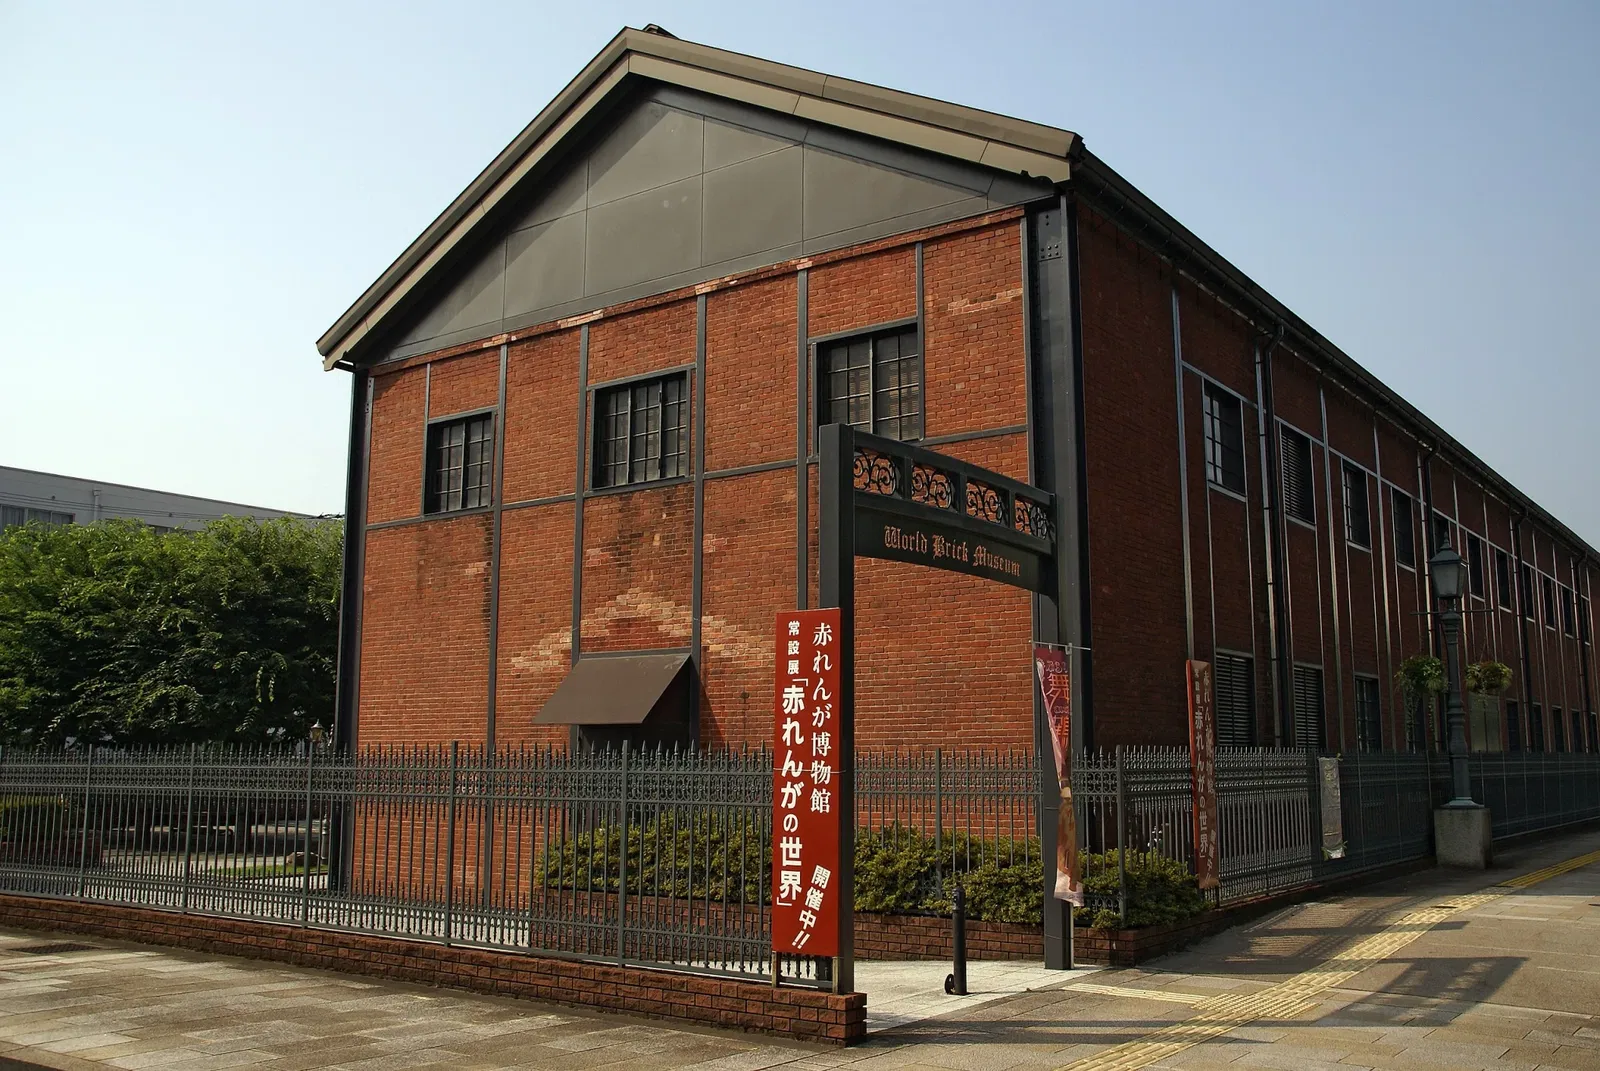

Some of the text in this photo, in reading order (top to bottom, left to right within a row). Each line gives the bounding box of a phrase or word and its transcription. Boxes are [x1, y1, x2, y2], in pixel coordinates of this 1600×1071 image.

[884, 525, 1021, 577] World Brick Museum
[810, 622, 833, 814] 赤れんが博物館
